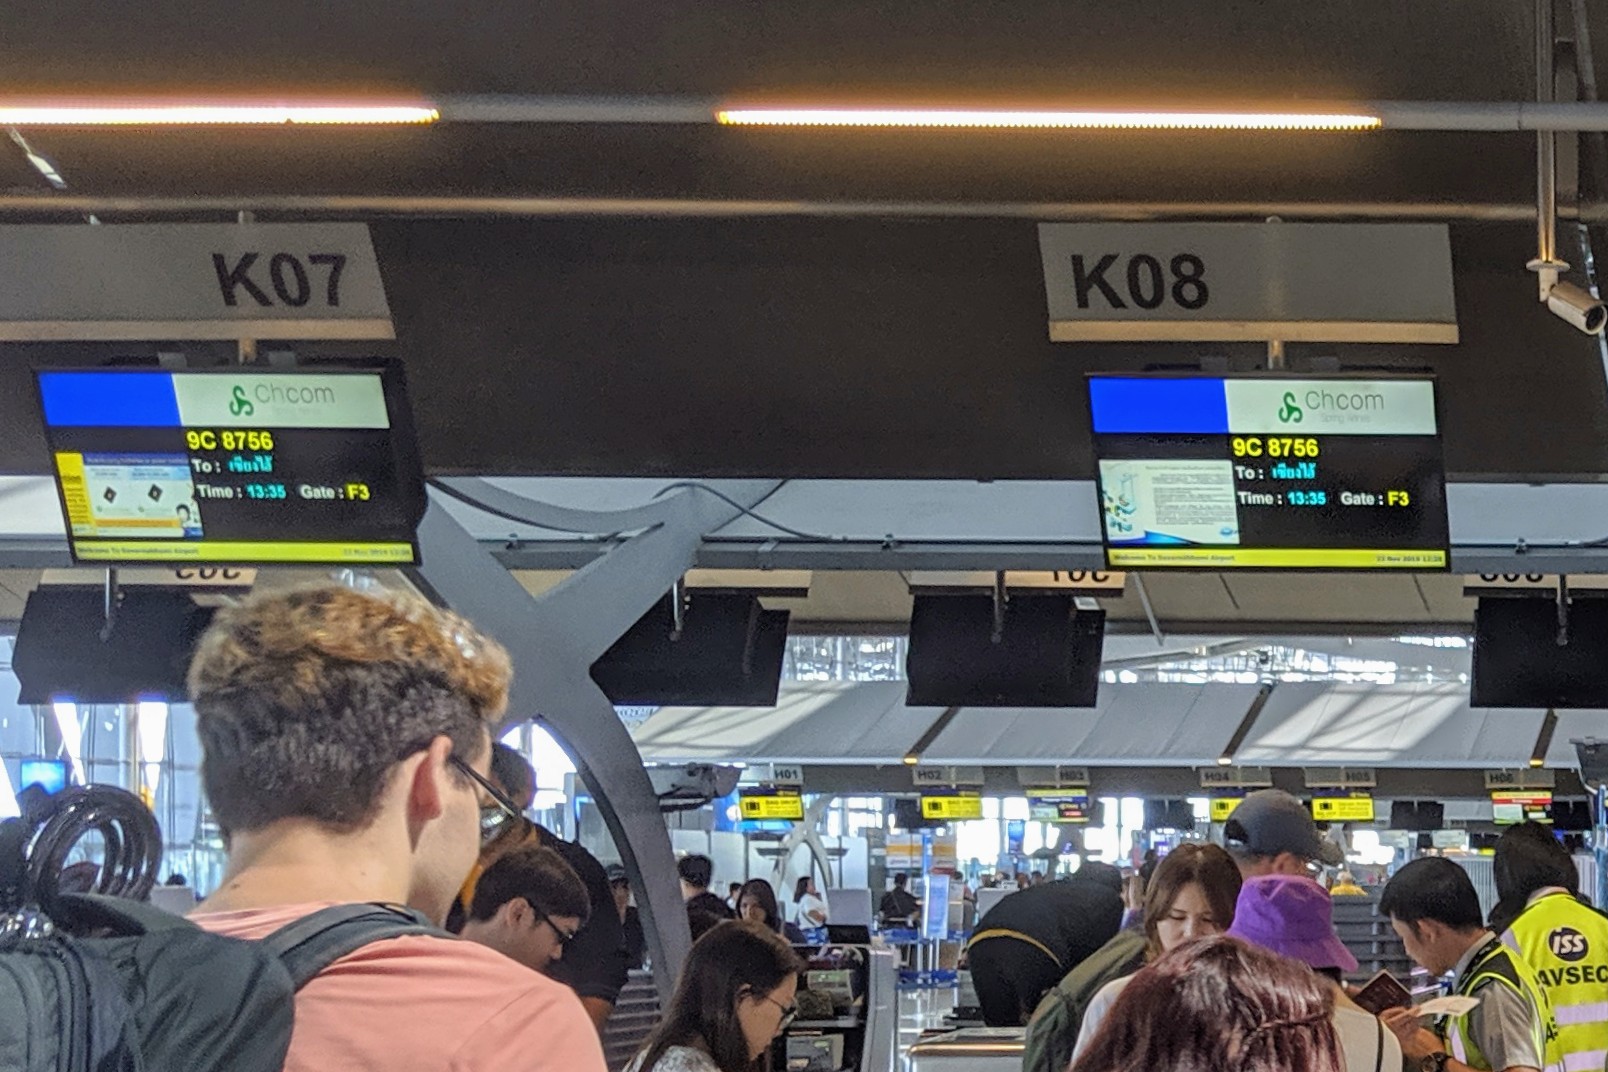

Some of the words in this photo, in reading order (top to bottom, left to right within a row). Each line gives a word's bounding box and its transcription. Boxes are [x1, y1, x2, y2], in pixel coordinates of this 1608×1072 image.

[211, 252, 347, 308] K07
[1070, 252, 1210, 310] K08
[1304, 389, 1384, 411] Chcom
[187, 431, 217, 451] 9C
[222, 431, 274, 451] 8756
[1232, 438, 1263, 457] 9C
[1267, 438, 1319, 457] 8756
[196, 484, 234, 499] Time
[246, 484, 287, 499] 13:35
[299, 484, 336, 499] Gate
[346, 483, 371, 500] F3
[1237, 491, 1274, 505] Time
[1287, 491, 1327, 506] 13:35
[1340, 491, 1375, 506] Gate
[1387, 491, 1410, 506] F3
[774, 769, 798, 780] H01
[917, 770, 941, 780] H02
